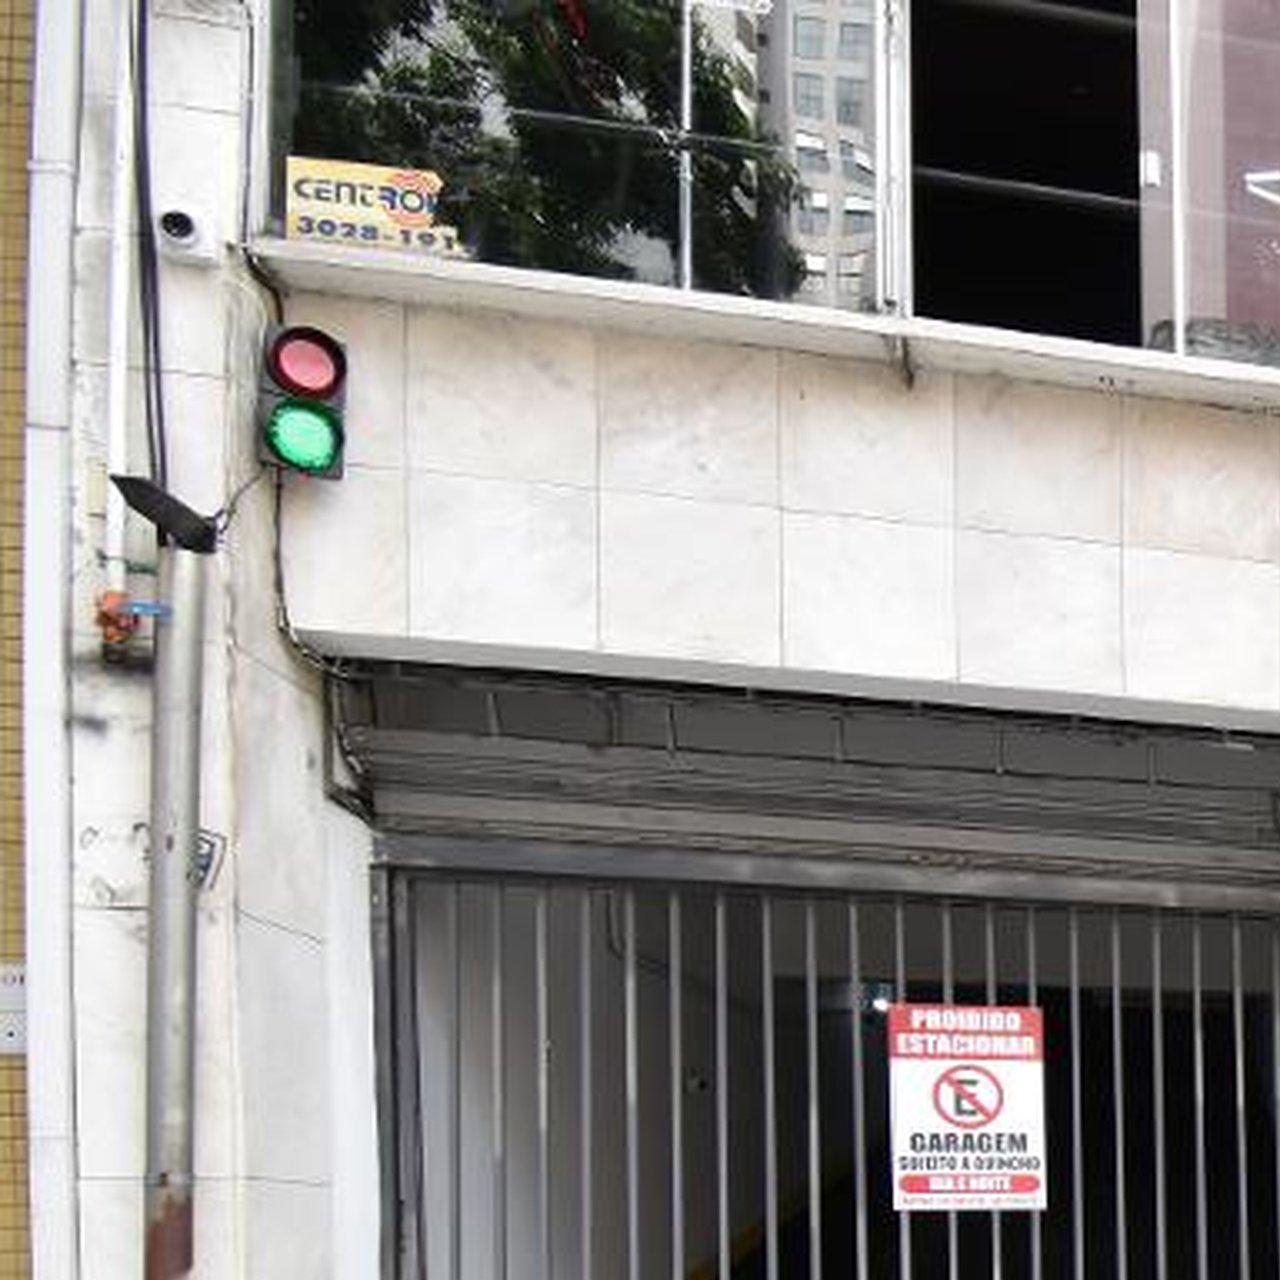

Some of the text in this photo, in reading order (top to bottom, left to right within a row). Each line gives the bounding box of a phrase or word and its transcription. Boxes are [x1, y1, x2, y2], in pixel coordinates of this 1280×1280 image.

[910, 1008, 1022, 1032] PROIBIDO
[897, 1031, 1035, 1055] ESTACIONAR
[909, 1132, 1028, 1153] GARAGEM
